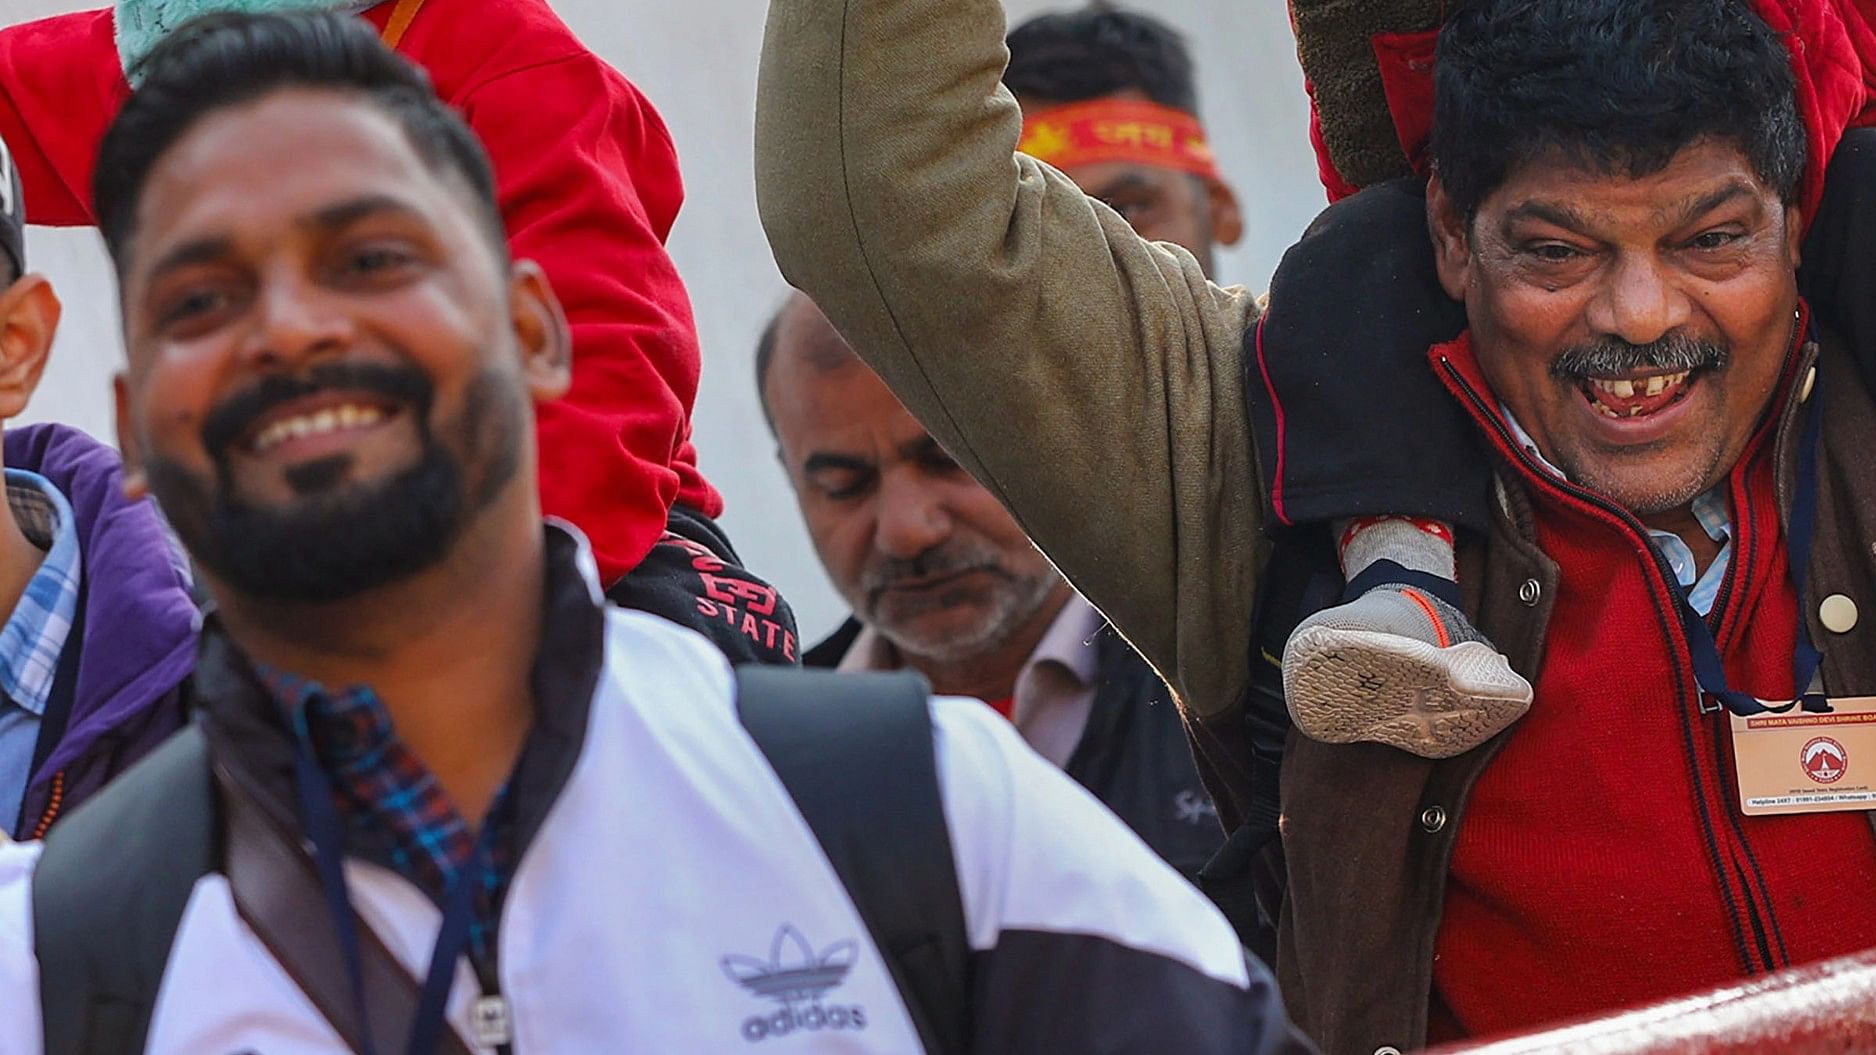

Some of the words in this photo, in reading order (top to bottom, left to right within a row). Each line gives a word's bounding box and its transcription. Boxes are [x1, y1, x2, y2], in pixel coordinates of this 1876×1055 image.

[696, 596, 796, 663] STATE
[1768, 718, 1787, 726] MATA
[1820, 716, 1836, 724] DEVI
[741, 1002, 868, 1043] adidas
